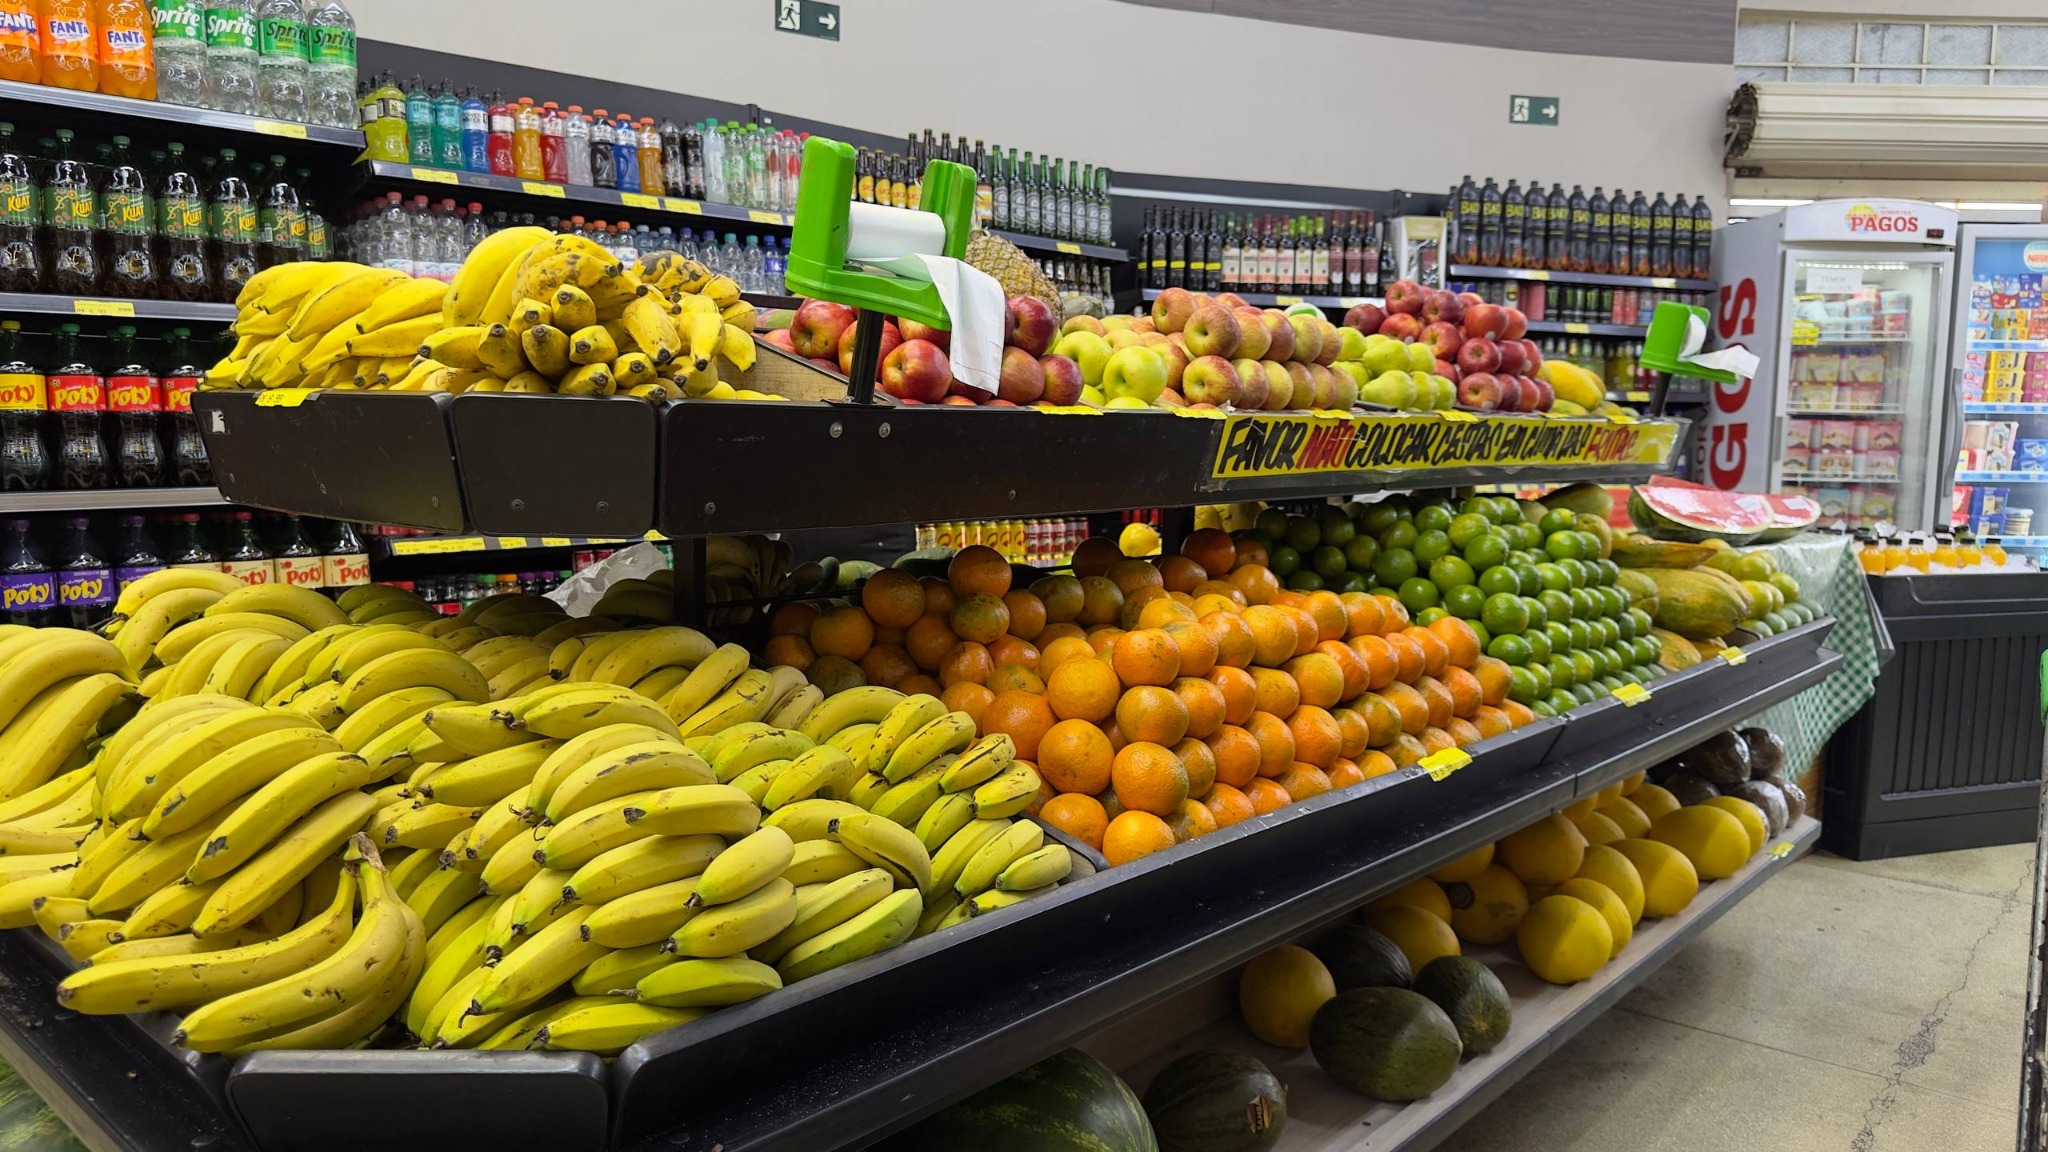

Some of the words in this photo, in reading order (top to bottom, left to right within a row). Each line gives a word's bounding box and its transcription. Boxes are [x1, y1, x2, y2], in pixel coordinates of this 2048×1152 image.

[0, 11, 37, 33] FANTA
[151, 4, 200, 29] Sprite
[208, 13, 256, 37] Sprite
[50, 20, 89, 35] FANTA
[107, 30, 145, 44] FANTA
[266, 21, 309, 43] Sprite
[314, 28, 356, 49] Sprite
[8, 195, 30, 212] KUAT
[72, 200, 93, 217] KUAT
[123, 204, 145, 221] KUAT
[1850, 216, 1919, 233] PAGOS
[0, 384, 36, 404] oty
[169, 389, 191, 410] Po
[1217, 417, 1308, 474] FAVOR
[1295, 419, 1356, 470] NÃO
[1344, 422, 1441, 469] COLOCAR
[1431, 419, 1504, 466] CESTAS
[286, 564, 323, 585] Poty
[339, 562, 370, 584] Poty
[3, 582, 50, 610] Poty
[60, 578, 103, 605] Poty
